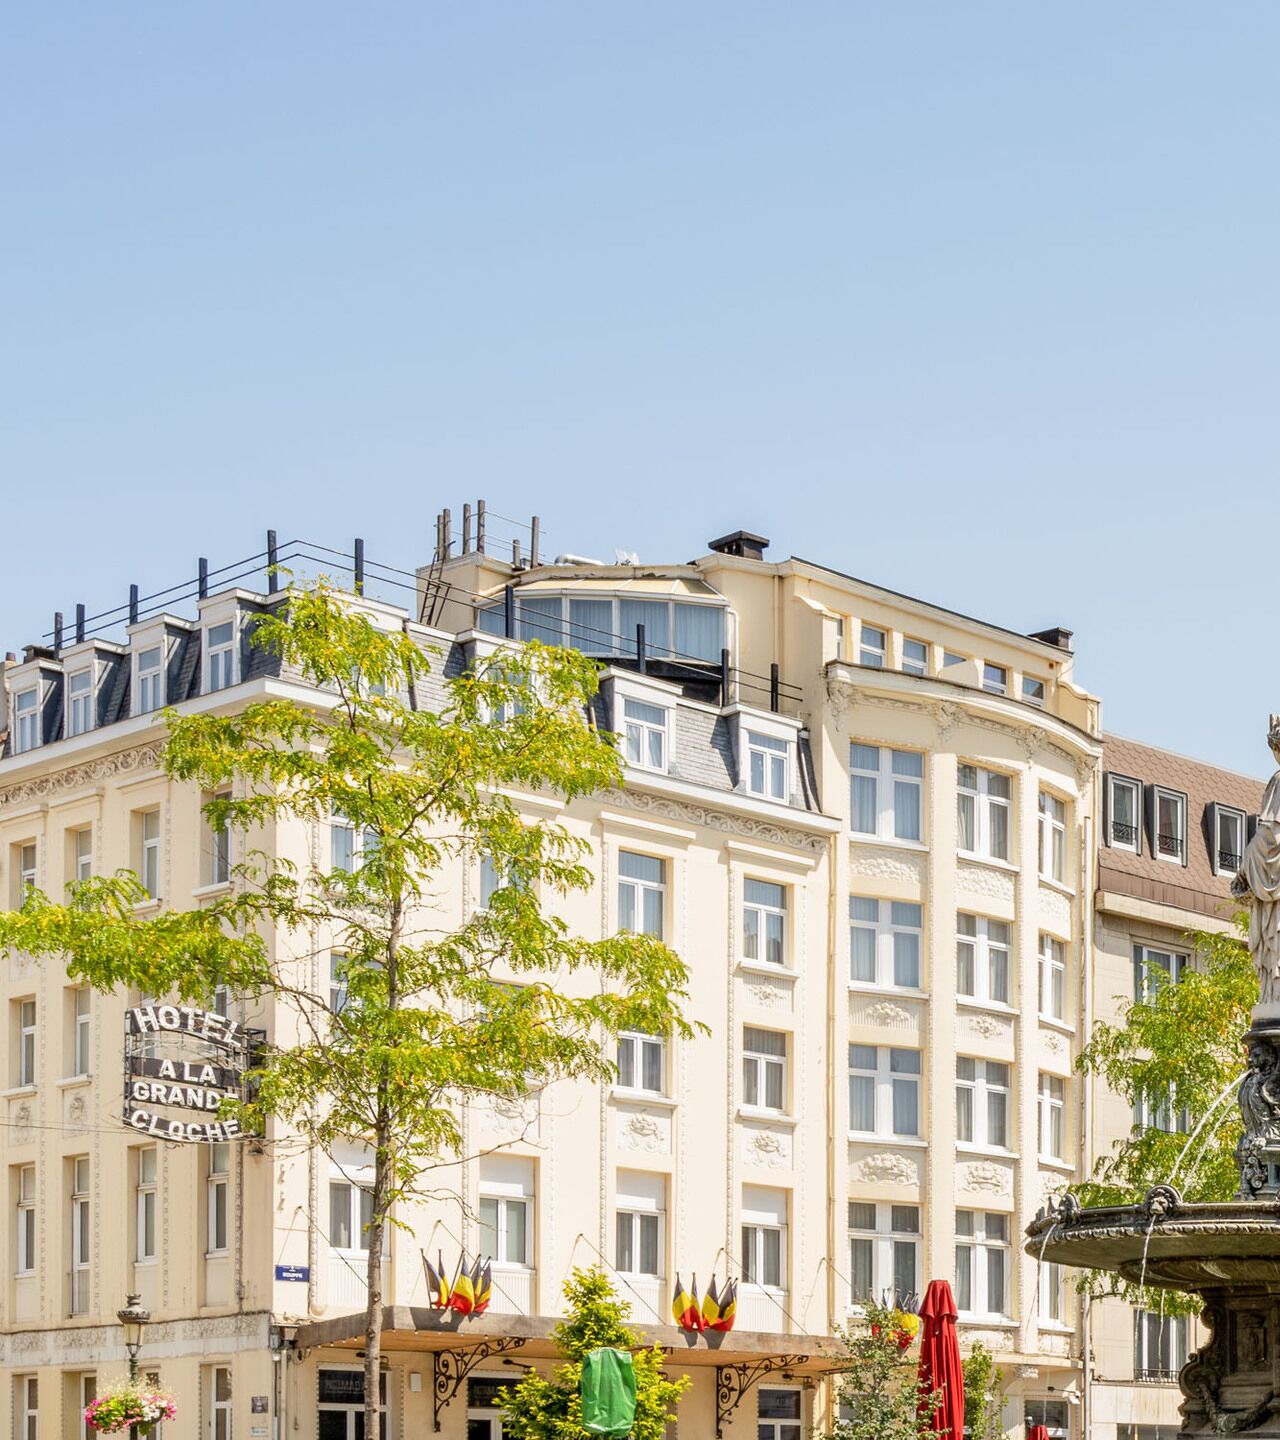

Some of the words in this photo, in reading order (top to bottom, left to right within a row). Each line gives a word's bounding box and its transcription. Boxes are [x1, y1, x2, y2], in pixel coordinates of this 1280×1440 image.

[133, 1006, 241, 1047] HOTEL
[159, 1059, 177, 1079] A
[183, 1062, 217, 1084] LA
[131, 1110, 241, 1141] CLOCHE
